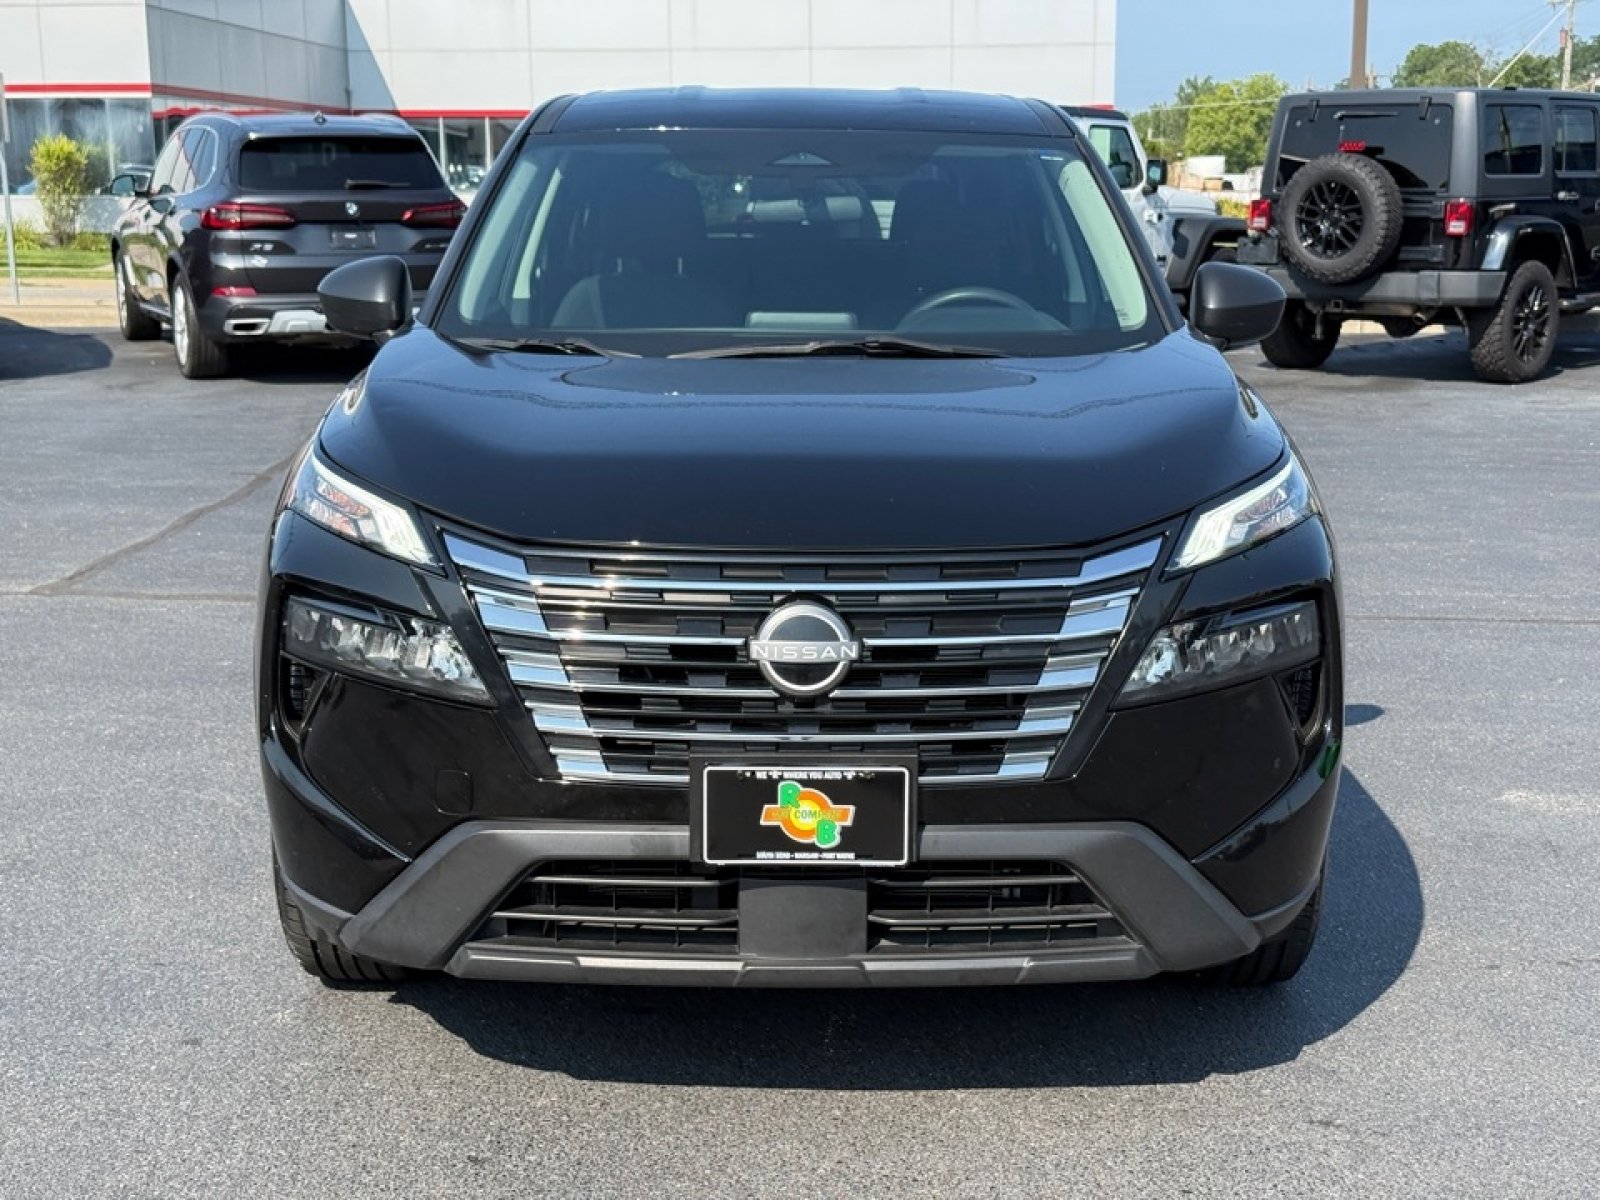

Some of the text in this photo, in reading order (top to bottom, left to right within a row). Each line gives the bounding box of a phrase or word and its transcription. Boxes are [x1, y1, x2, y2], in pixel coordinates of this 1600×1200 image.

[752, 644, 857, 659] NISSAN
[779, 782, 801, 808] R
[816, 819, 838, 846] B
